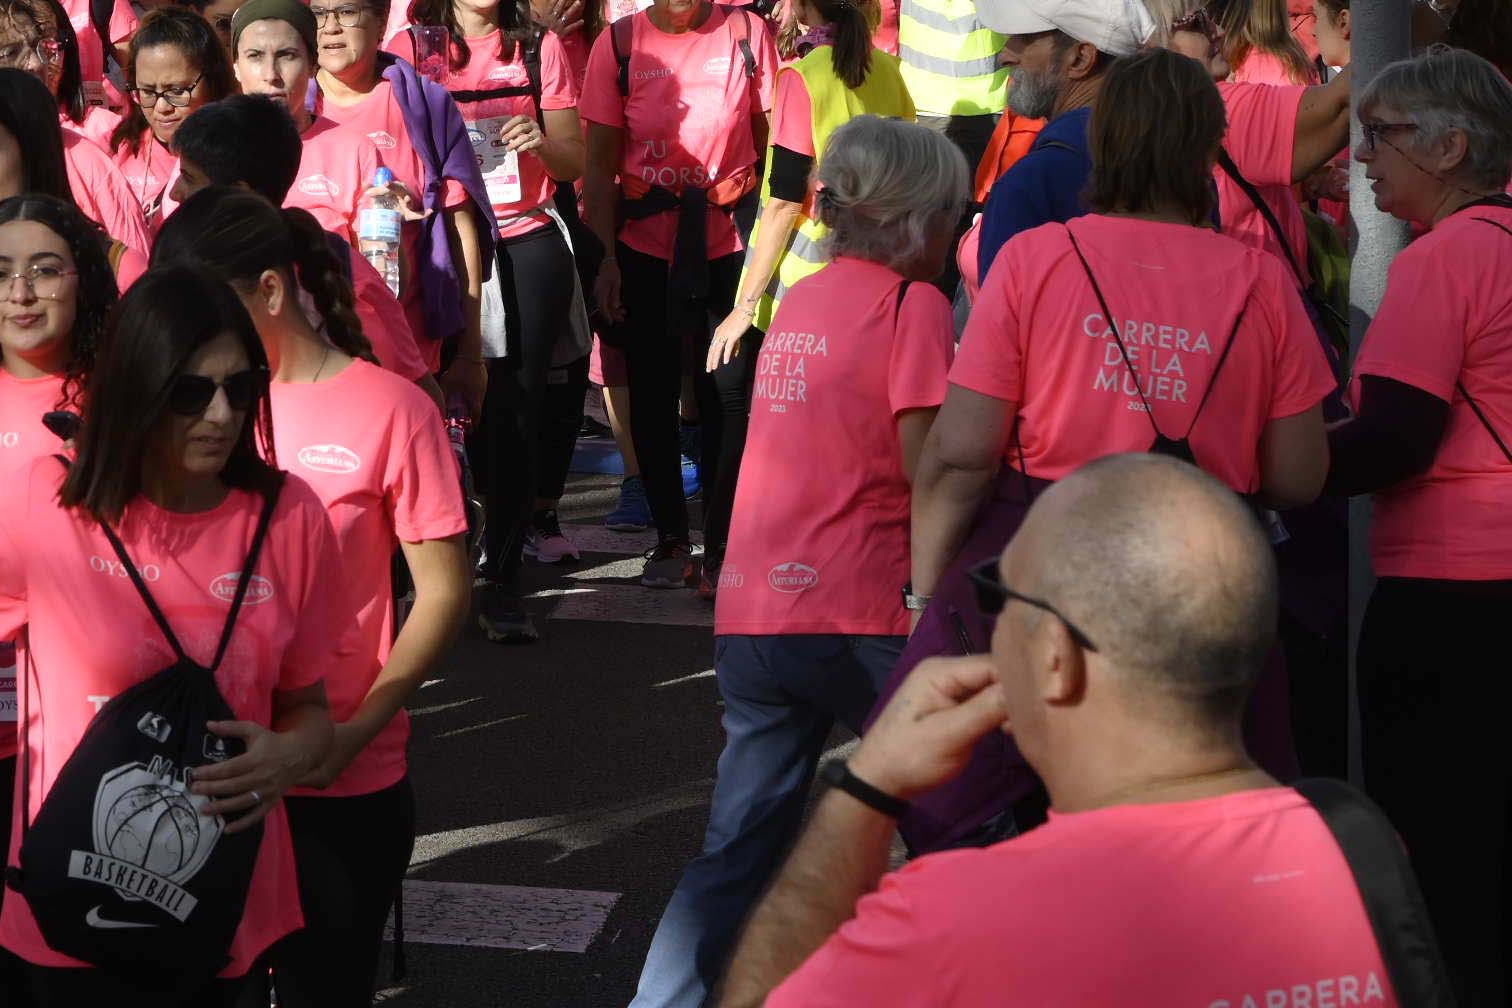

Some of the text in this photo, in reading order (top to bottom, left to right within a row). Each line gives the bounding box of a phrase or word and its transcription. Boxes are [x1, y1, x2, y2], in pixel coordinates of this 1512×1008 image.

[760, 332, 829, 357] ARRERA
[1083, 313, 1213, 356] CARRERA
[760, 354, 806, 379] DE LA
[1151, 348, 1185, 377] LA
[754, 378, 807, 403] MUJER
[1093, 367, 1188, 404] MUJER
[82, 854, 187, 913] BASKETBALL
